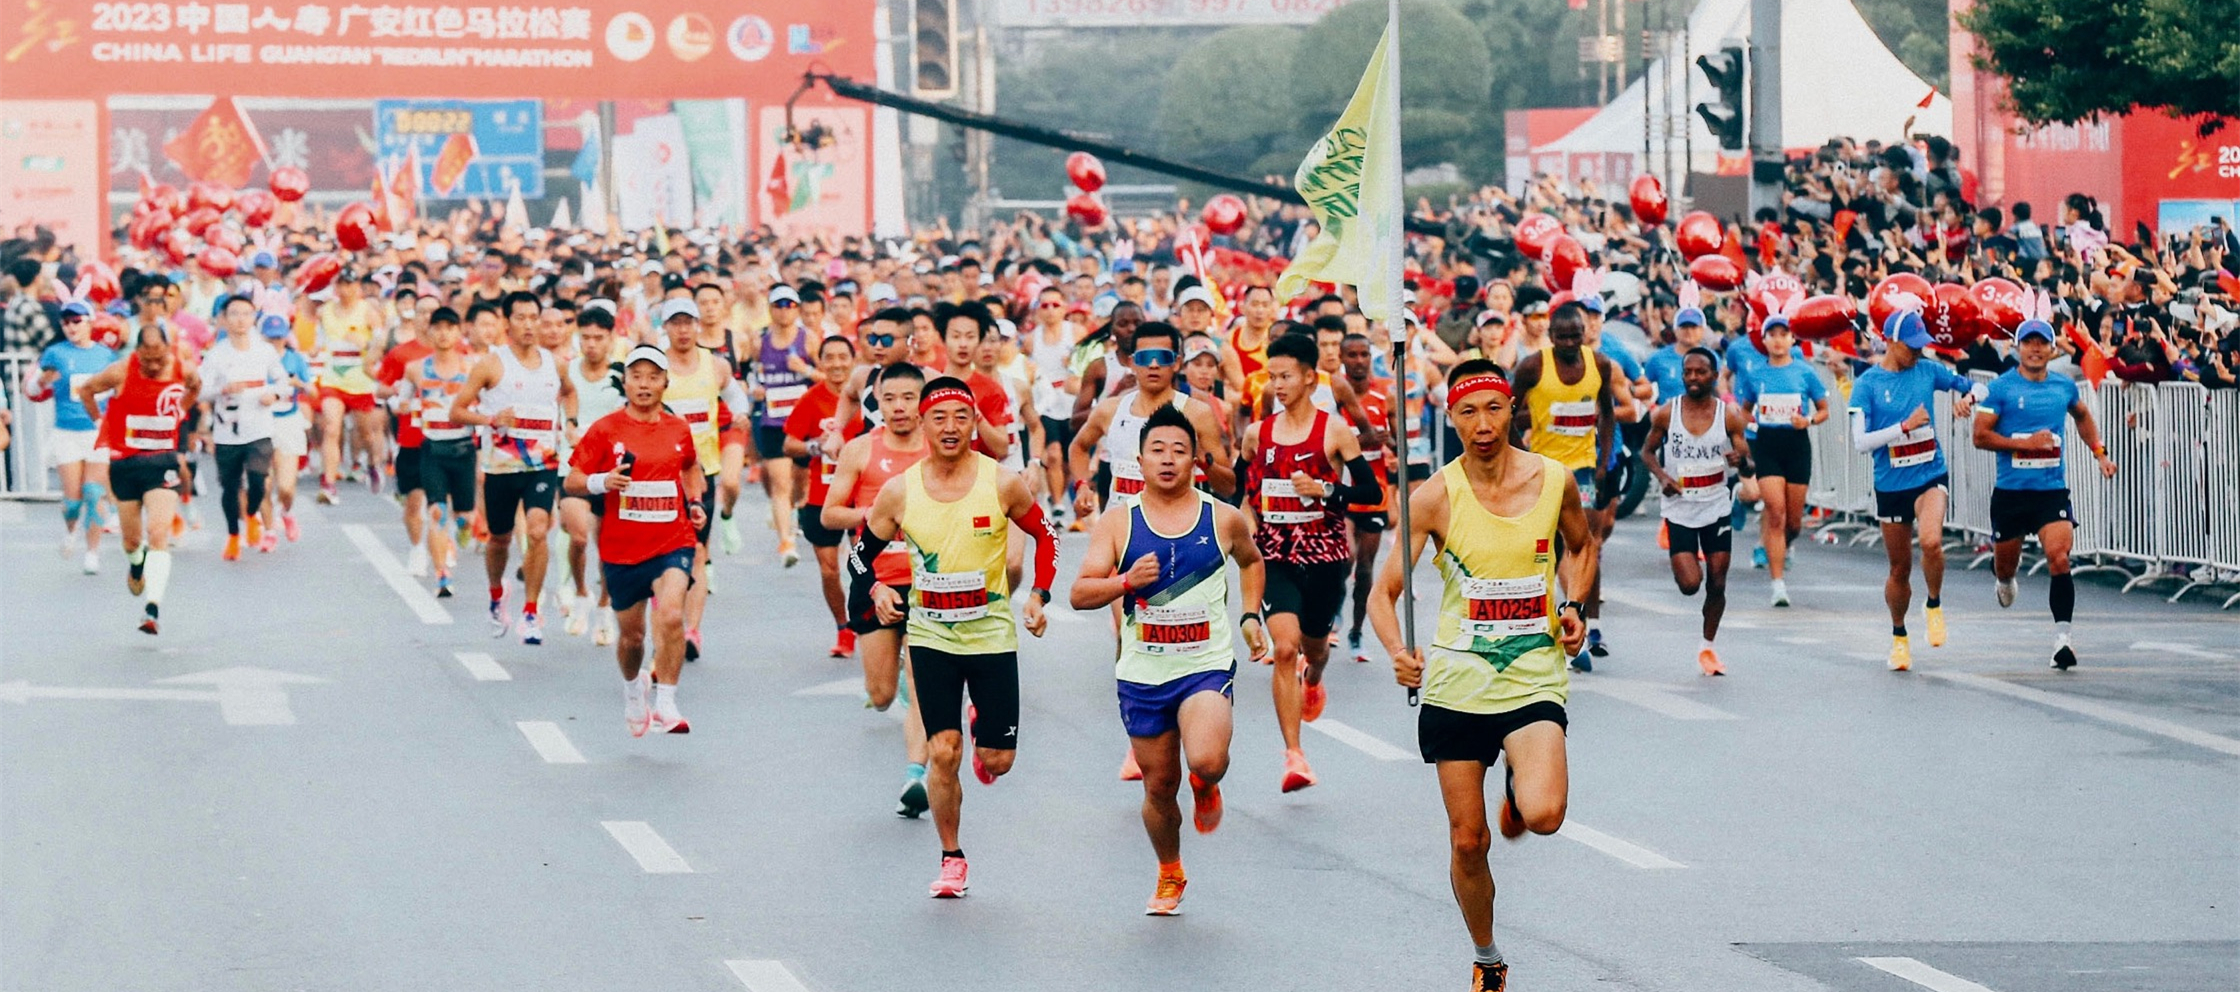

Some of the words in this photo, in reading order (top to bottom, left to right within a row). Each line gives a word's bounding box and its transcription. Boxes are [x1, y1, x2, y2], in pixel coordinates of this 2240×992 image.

[91, 3, 171, 32] 2023
[176, 1, 332, 36] 中国人寿
[337, 4, 592, 39] 广安红色马拉松赛
[92, 42, 184, 62] CHINA
[190, 44, 252, 63] LIFE
[928, 588, 983, 610] A11576
[1476, 597, 1542, 621] A10254
[1148, 622, 1206, 643] A10307
